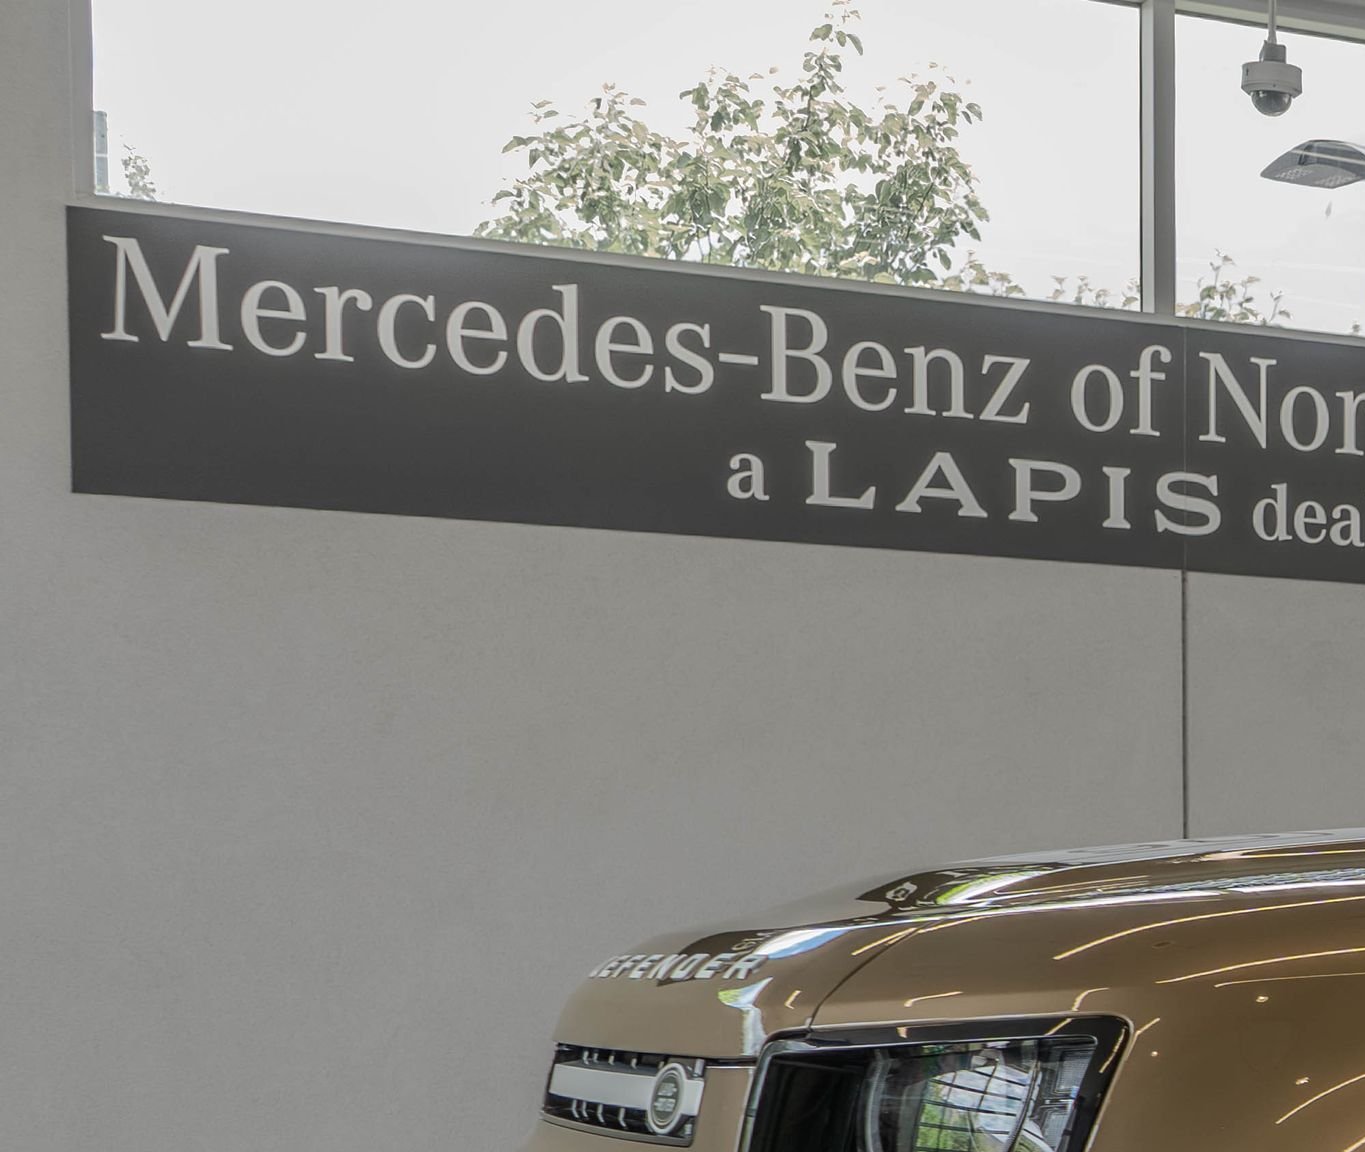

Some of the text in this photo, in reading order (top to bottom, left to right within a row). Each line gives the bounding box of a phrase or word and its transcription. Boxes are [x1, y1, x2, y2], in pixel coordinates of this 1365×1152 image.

[100, 235, 1031, 424] Mercedes-Benz
[1070, 344, 1173, 437] of
[727, 453, 770, 501] a
[806, 441, 1221, 535] LAPIS
